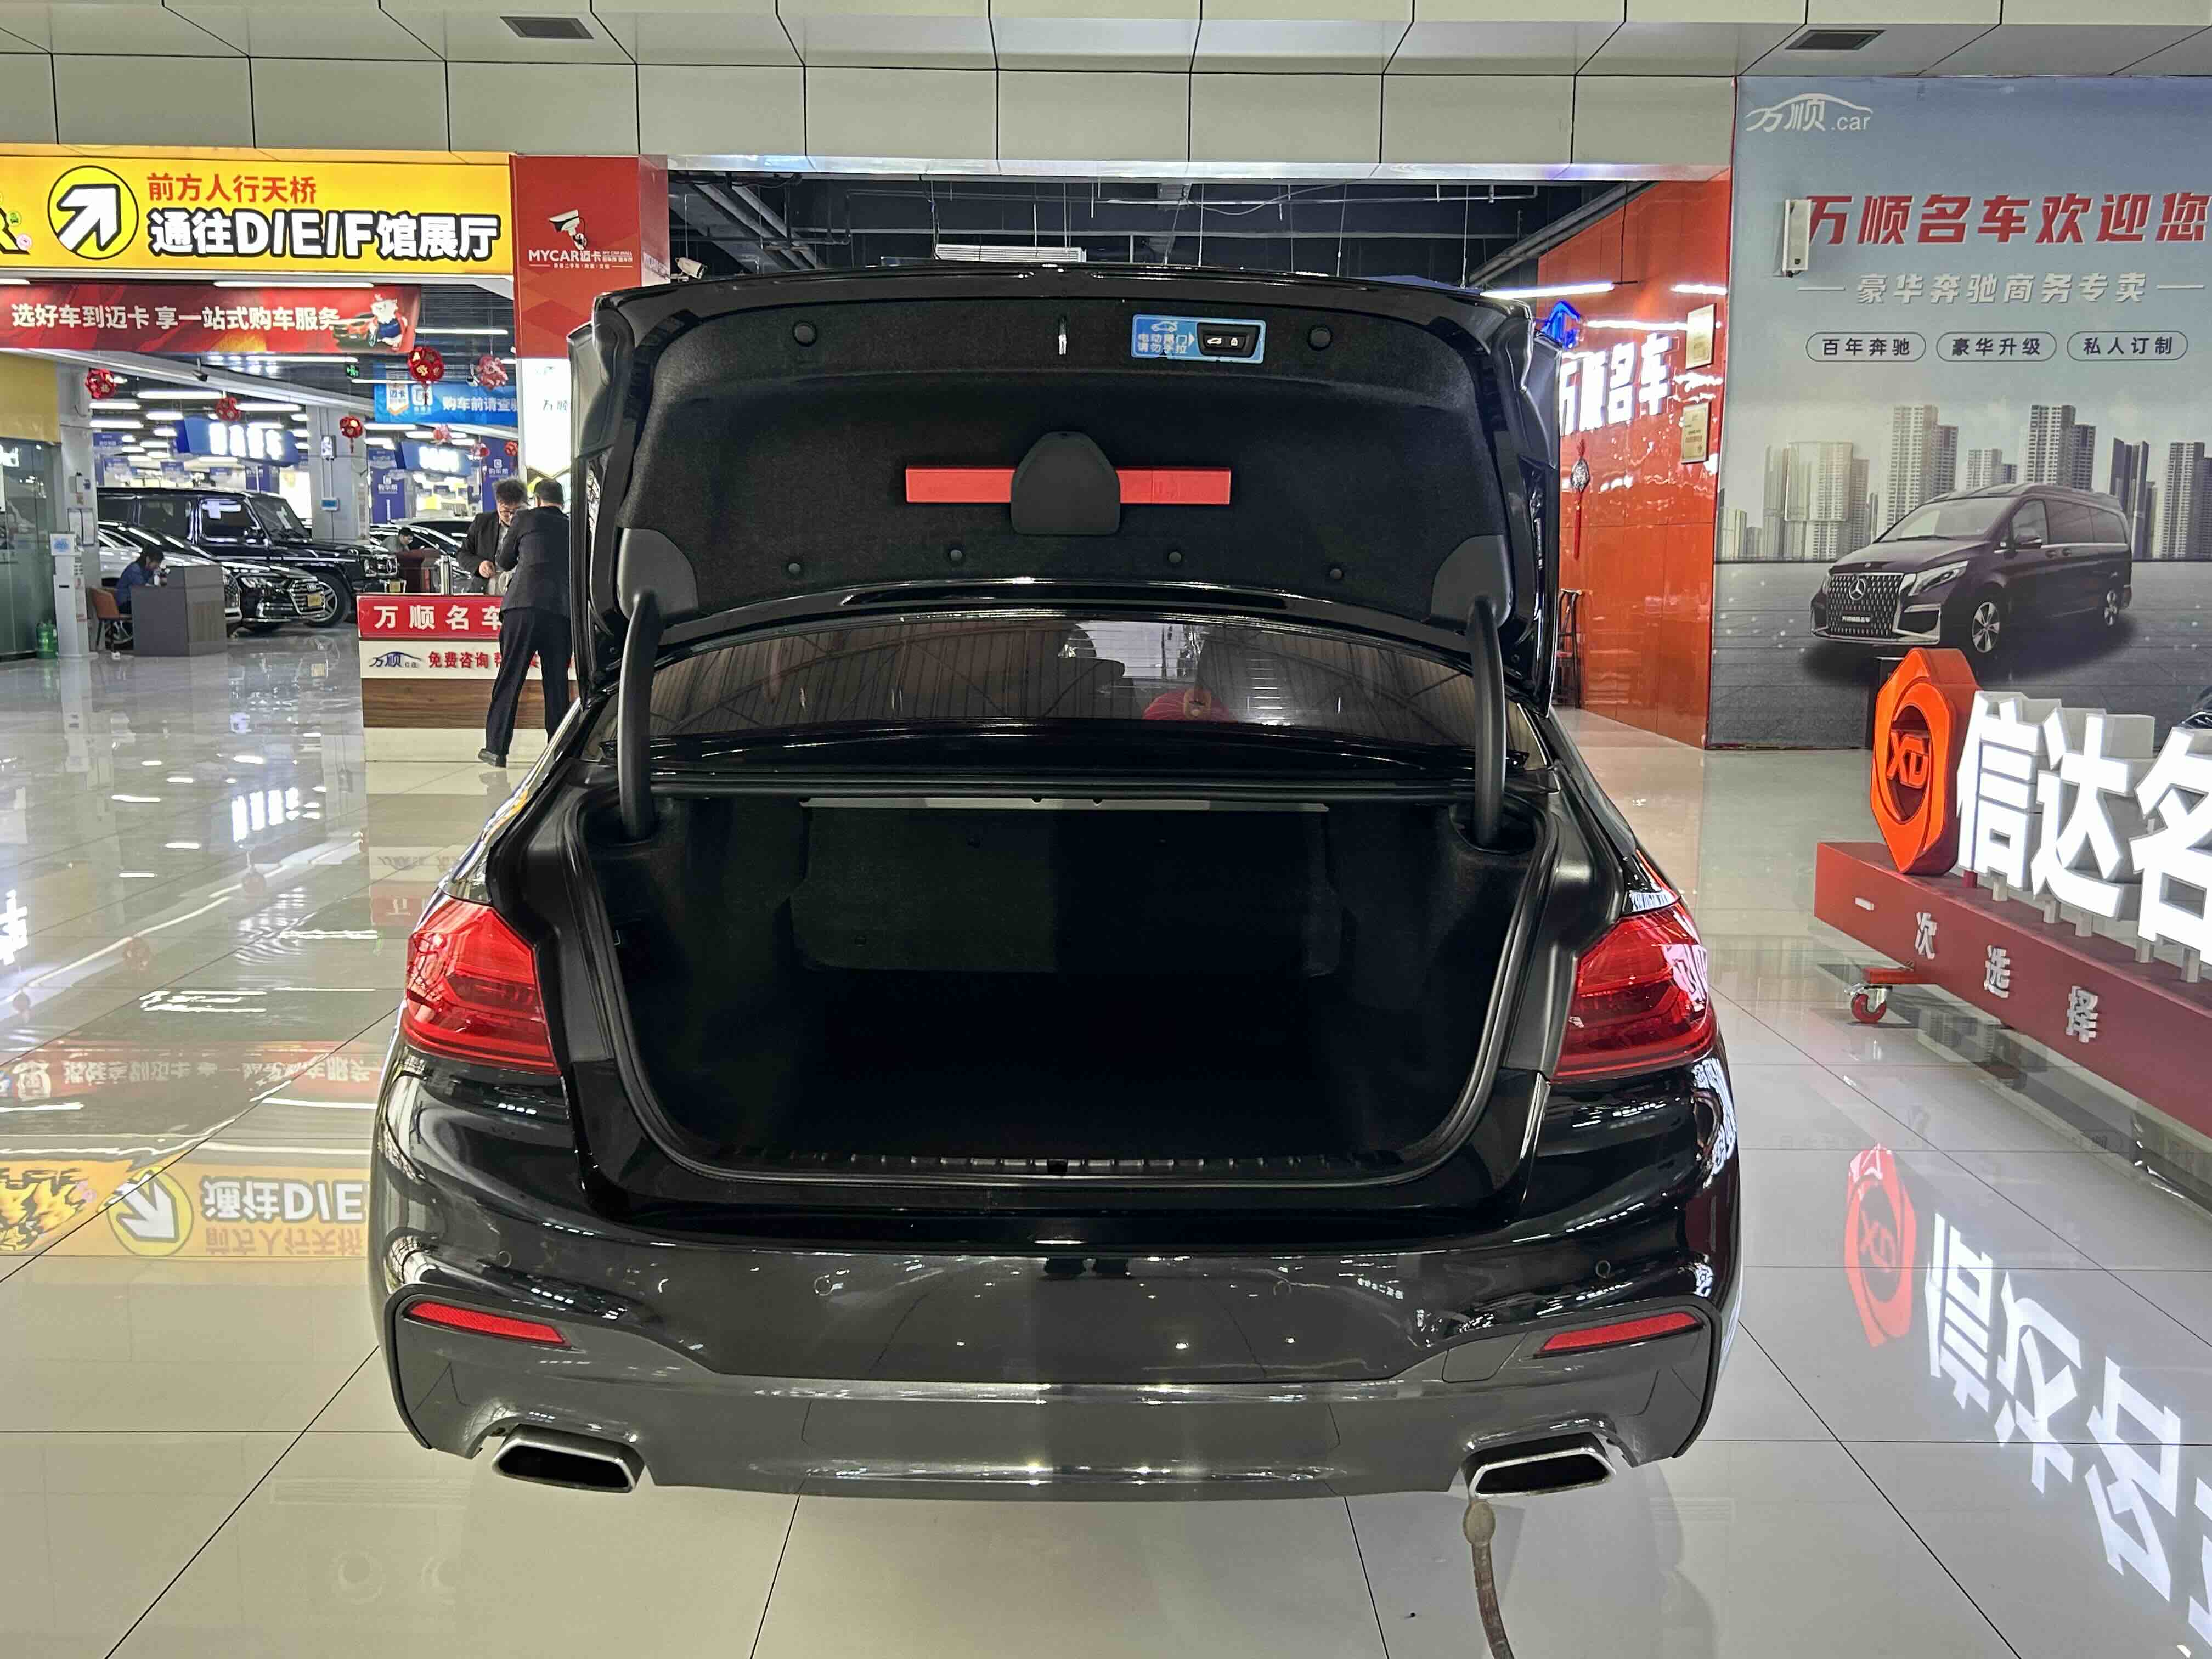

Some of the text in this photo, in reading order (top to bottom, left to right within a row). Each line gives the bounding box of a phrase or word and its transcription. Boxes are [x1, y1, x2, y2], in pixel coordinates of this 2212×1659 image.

[147, 173, 317, 204] 前方人行天桥
[1807, 192, 2212, 245] 万顺名车欢迎您
[149, 208, 500, 258] 通往D/E/F馆展厅
[1856, 272, 2147, 303] 豪华奔驰商务专卖
[11, 303, 340, 331] 选好车到迈卡 享一站式购车服务
[1822, 338, 1910, 357] 百年奔驰
[1952, 337, 2041, 357] 豪华升级
[2083, 336, 2174, 356] 私人订制
[374, 605, 502, 630] 万顺名车
[428, 651, 489, 669] 免费咨询
